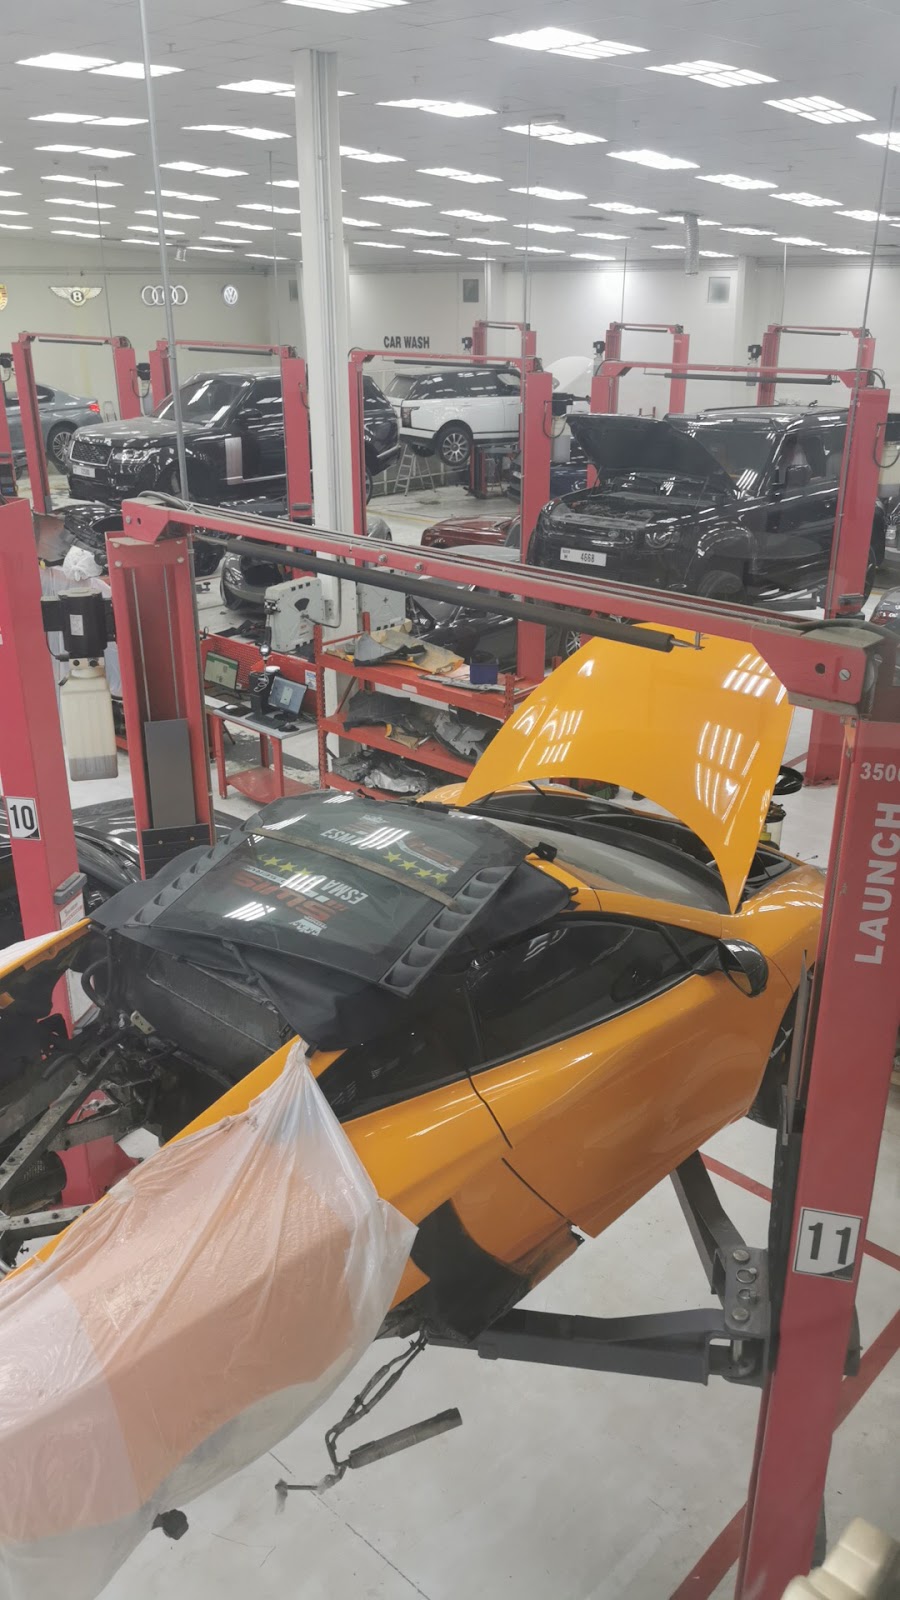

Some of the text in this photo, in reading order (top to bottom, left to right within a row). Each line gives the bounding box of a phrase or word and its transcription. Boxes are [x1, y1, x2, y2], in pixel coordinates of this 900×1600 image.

[383, 335, 430, 350] CAR WASH
[9, 804, 36, 831] 10
[320, 878, 369, 905] ESMA
[854, 802, 900, 965] LAUNCH
[807, 1221, 852, 1266] 11
